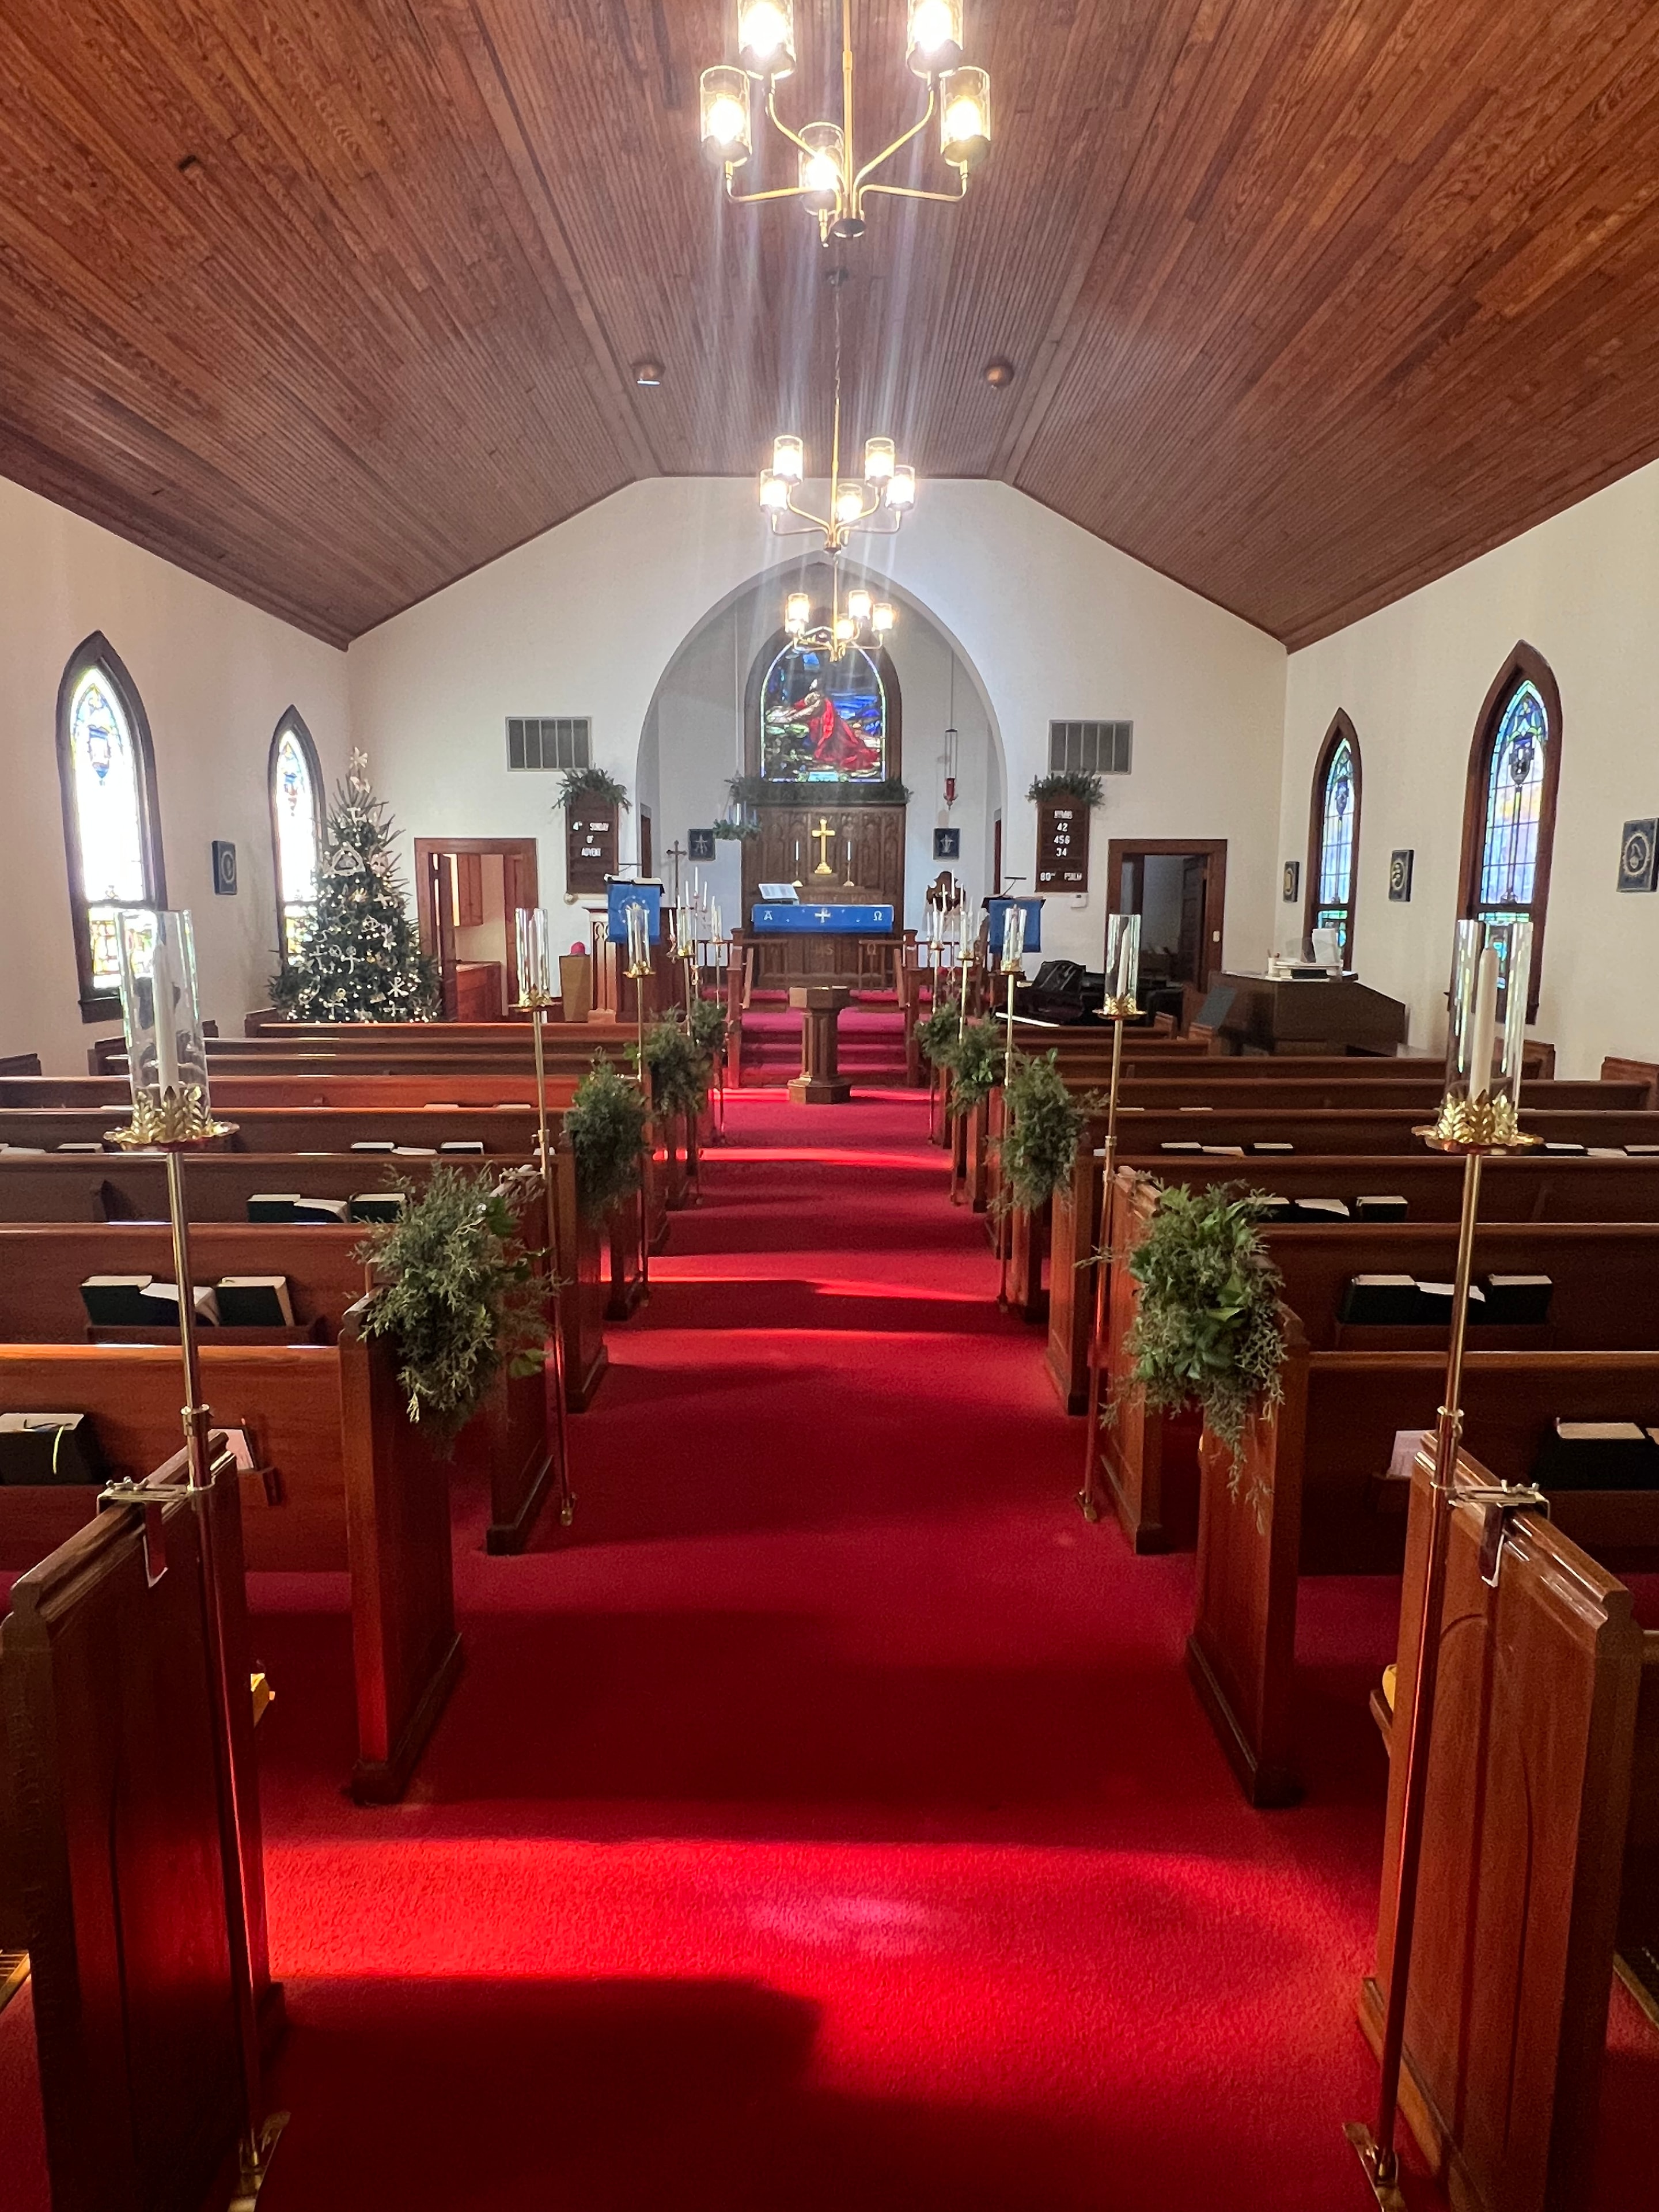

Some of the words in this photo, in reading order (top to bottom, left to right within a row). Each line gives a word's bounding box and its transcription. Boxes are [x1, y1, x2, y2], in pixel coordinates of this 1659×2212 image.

[1056, 823, 1069, 832] 42
[586, 835, 594, 844] OF
[1054, 835, 1070, 844] 456
[1056, 847, 1067, 857] 34
